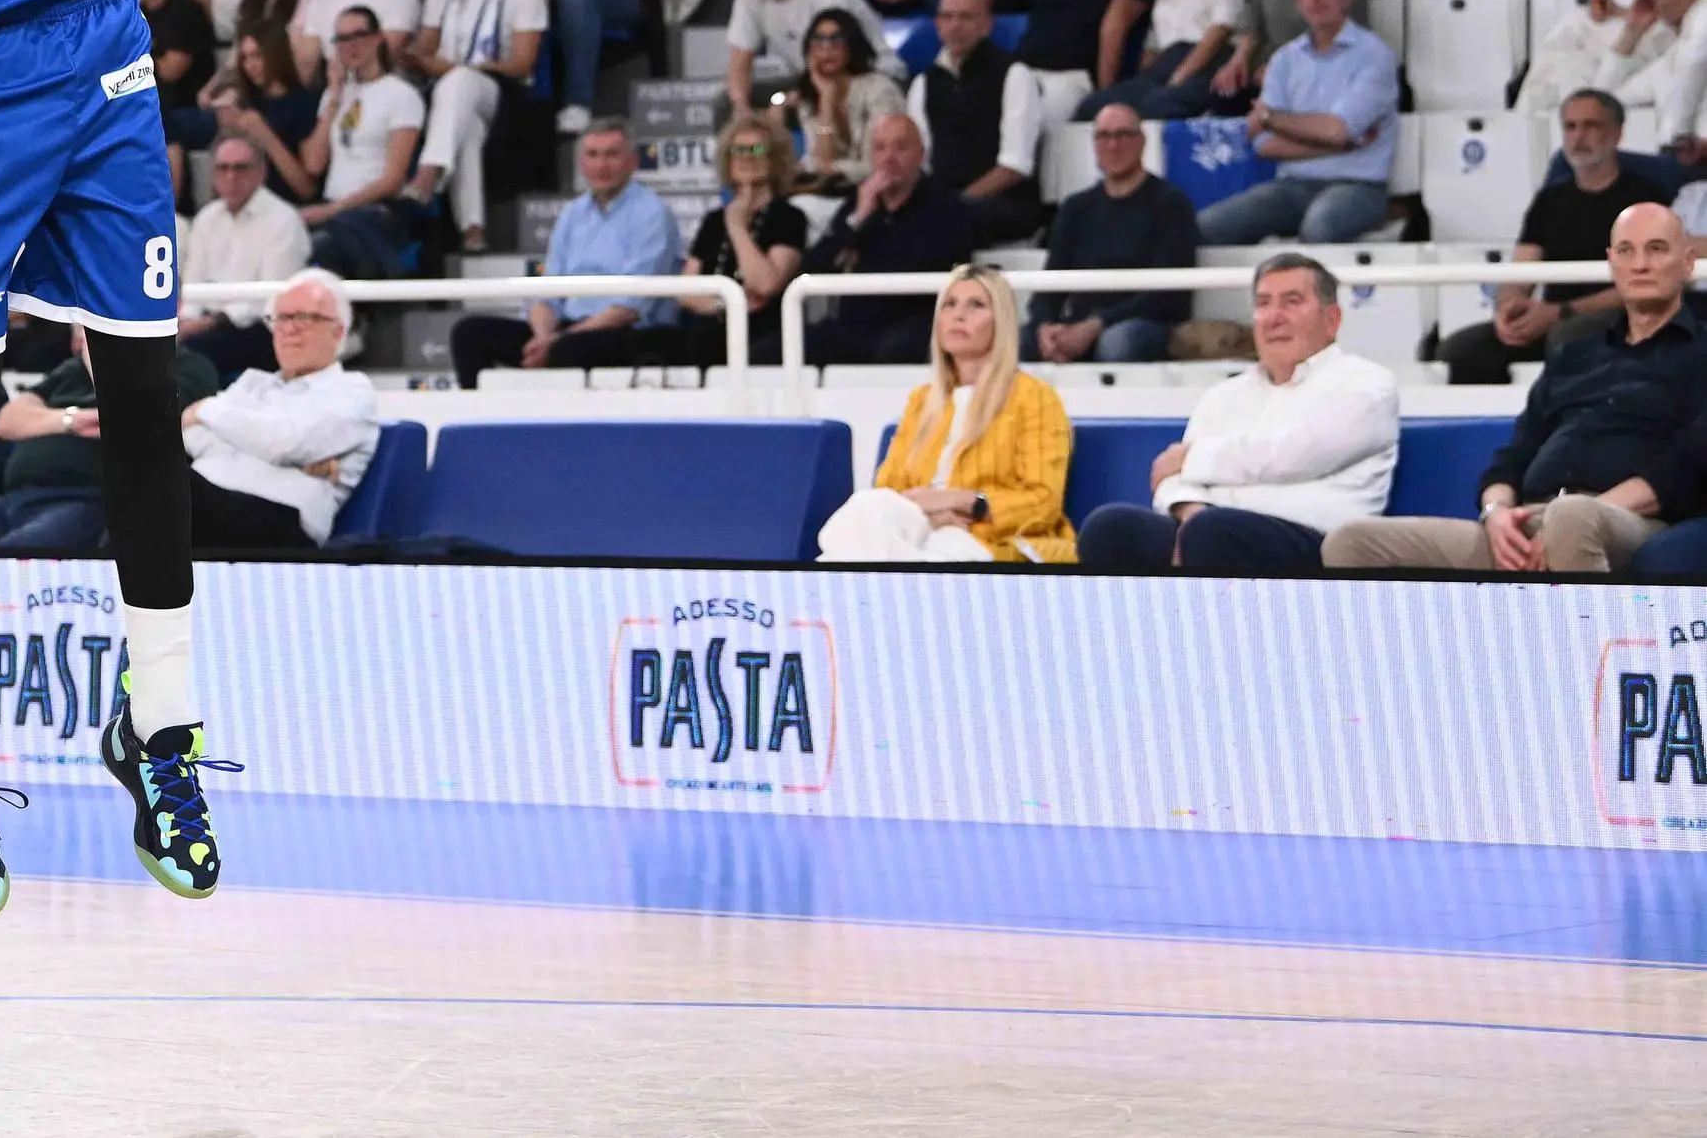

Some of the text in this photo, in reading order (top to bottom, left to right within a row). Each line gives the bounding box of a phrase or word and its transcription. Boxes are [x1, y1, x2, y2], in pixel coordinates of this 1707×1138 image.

[143, 236, 173, 299] 8
[27, 586, 115, 614] ADESSO
[672, 598, 775, 629] ADESSO
[630, 637, 814, 763] PASTA
